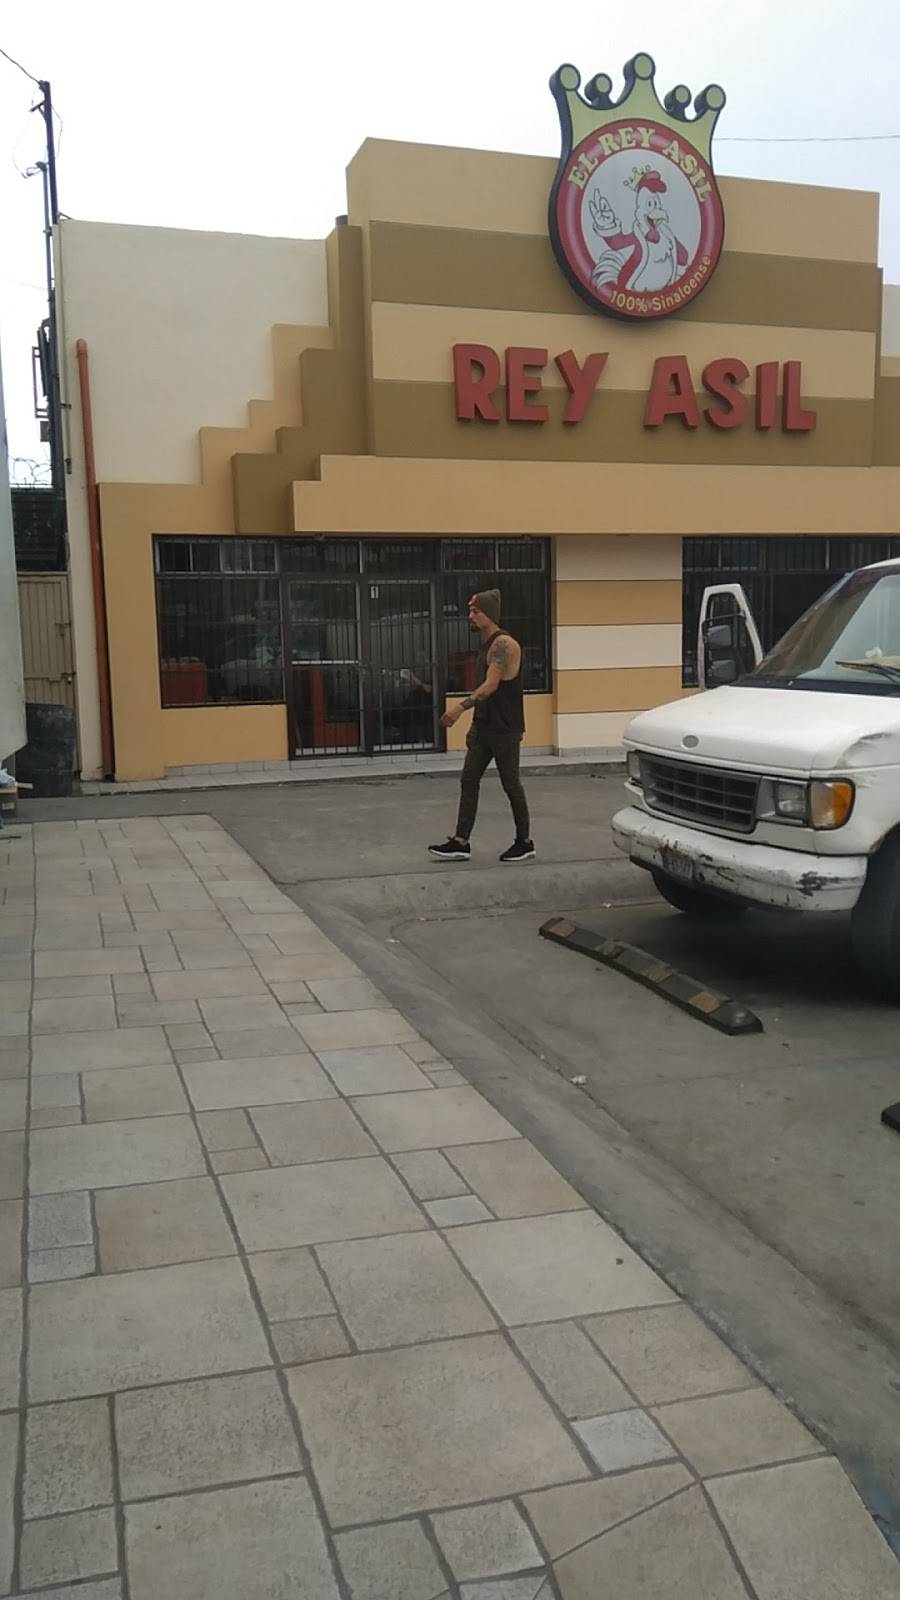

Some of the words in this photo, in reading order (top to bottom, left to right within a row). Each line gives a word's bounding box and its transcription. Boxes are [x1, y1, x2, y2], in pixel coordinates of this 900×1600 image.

[568, 153, 598, 190] EL
[598, 127, 656, 156] REY
[662, 140, 713, 202] ASIL
[610, 290, 648, 313] 100%
[652, 255, 711, 312] Sinaloense
[452, 343, 610, 425] REY
[643, 355, 817, 431] ASIL
